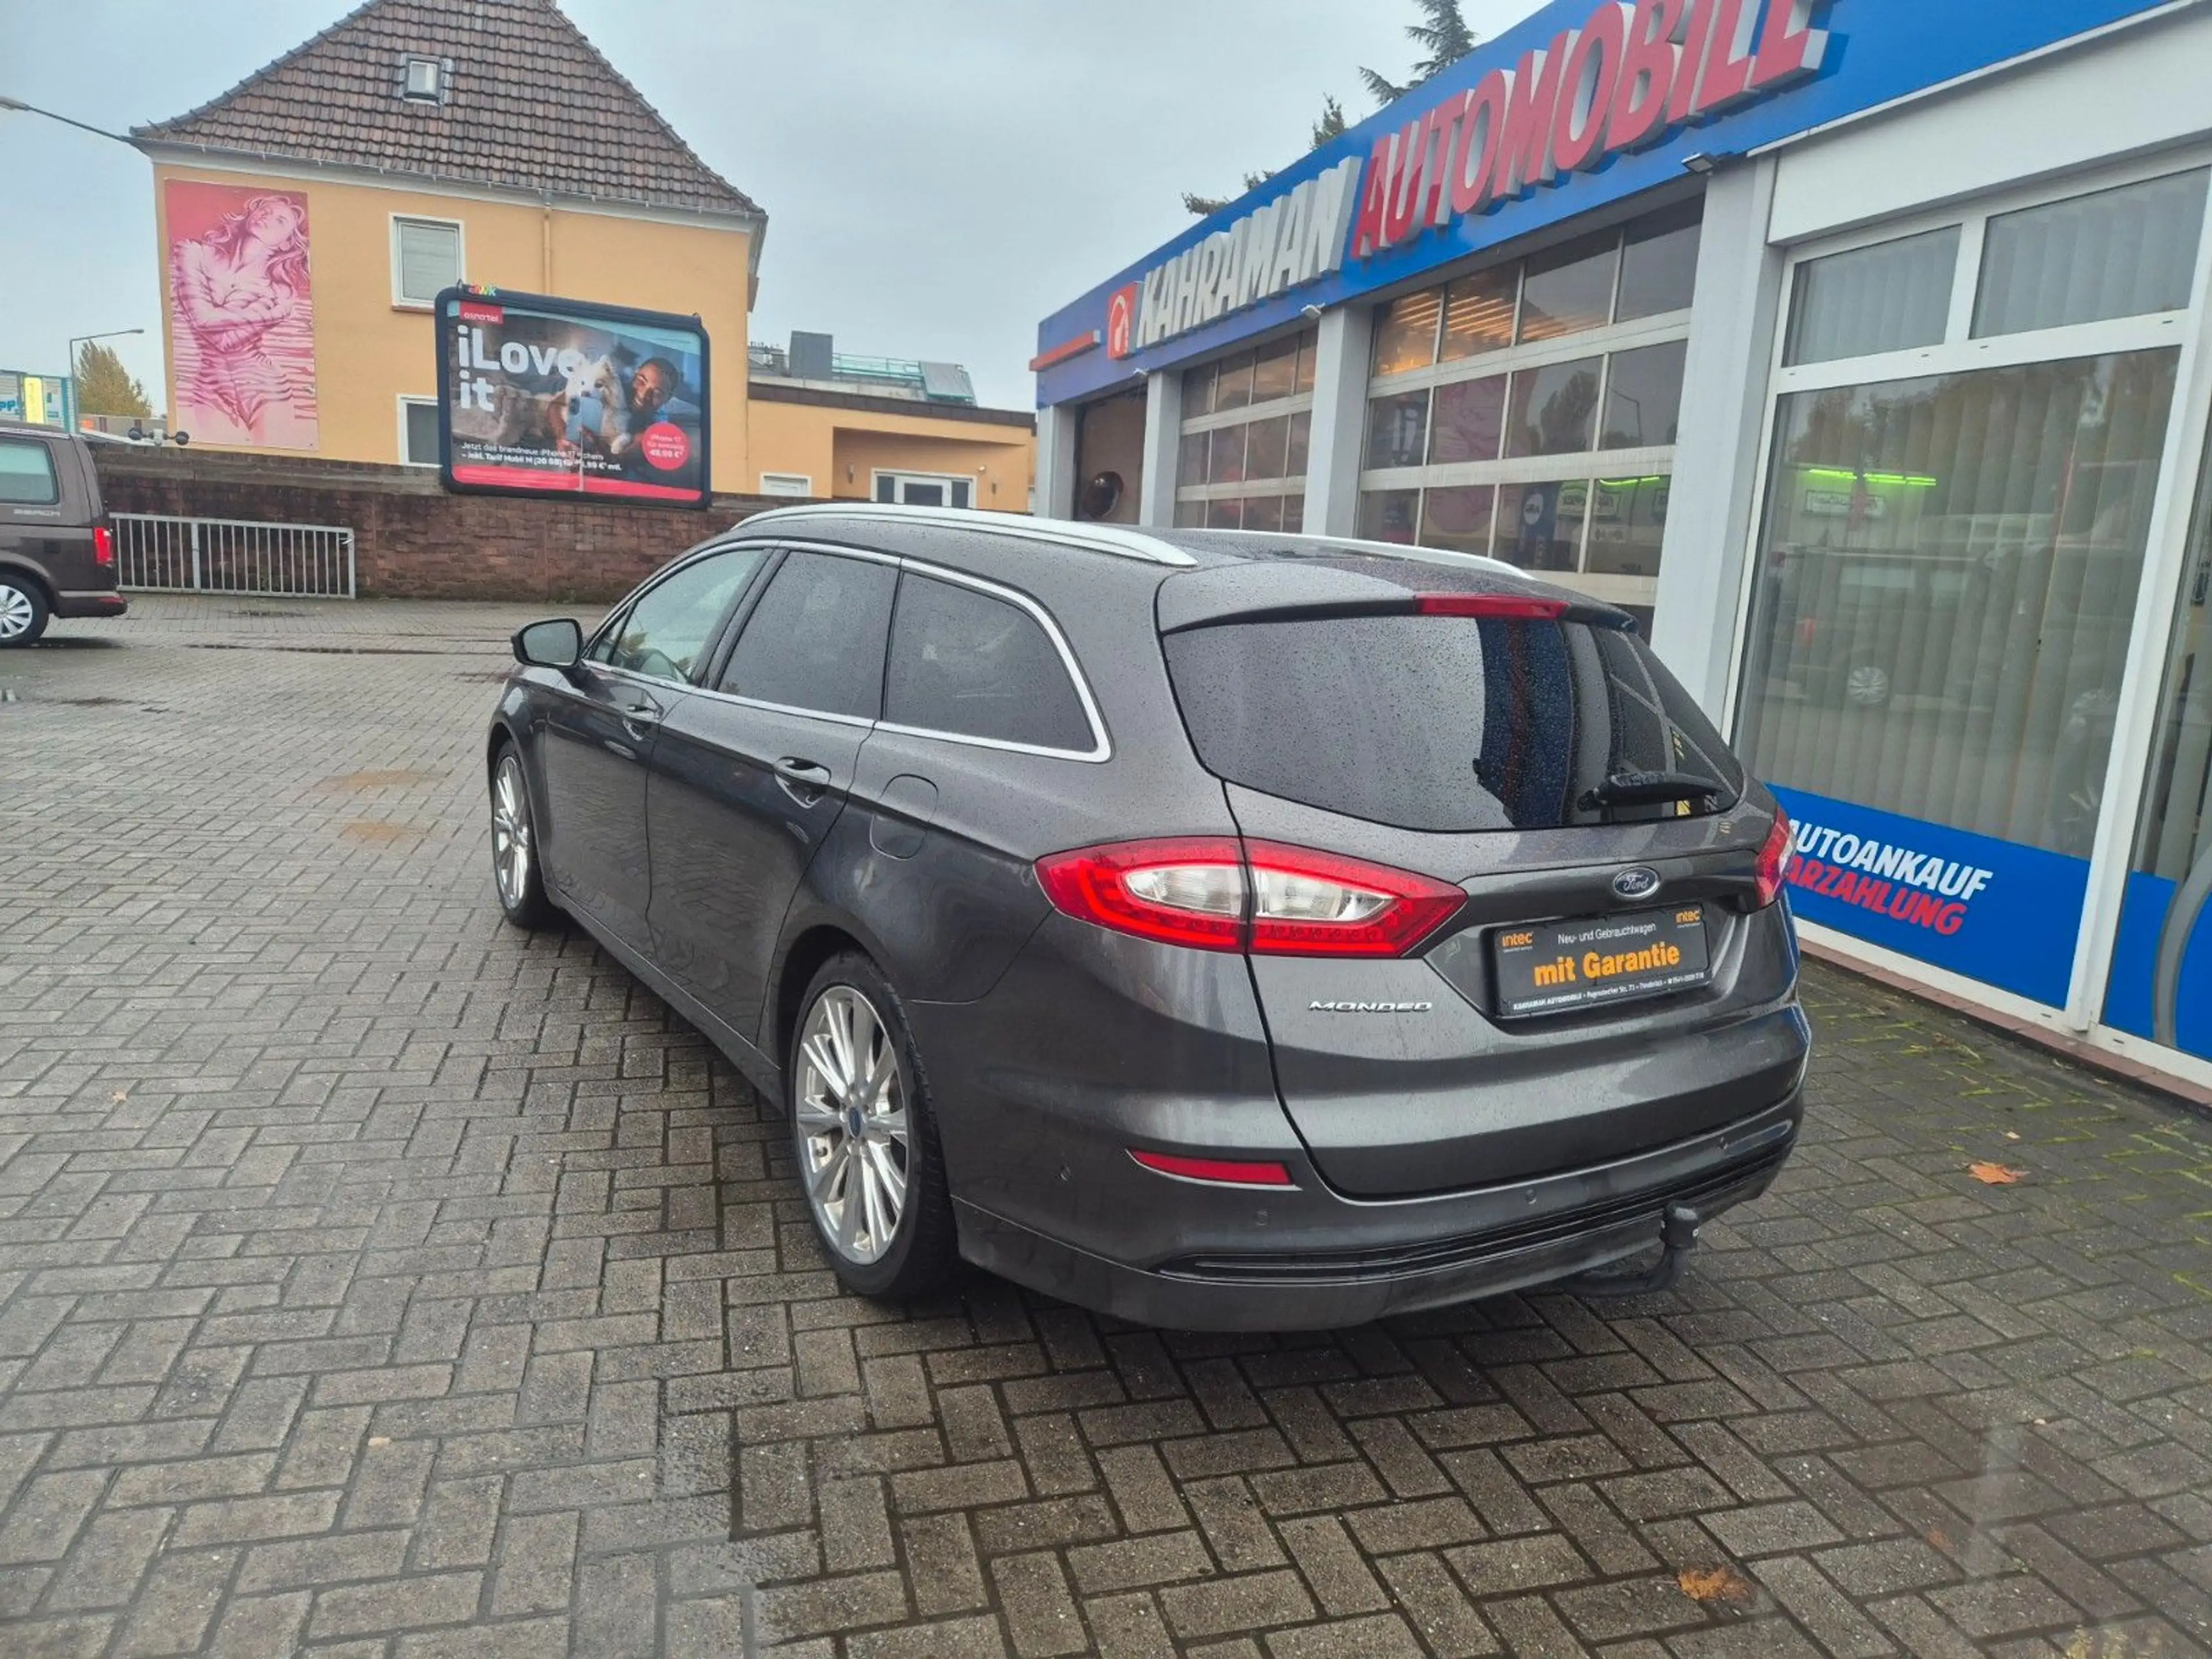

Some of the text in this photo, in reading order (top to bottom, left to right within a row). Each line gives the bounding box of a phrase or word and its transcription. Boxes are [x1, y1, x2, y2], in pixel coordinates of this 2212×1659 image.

[1137, 156, 1363, 349] KAHRAMAN
[459, 369, 494, 412] it
[462, 442, 482, 450] Jetzt
[1623, 874, 1649, 891] Ford
[1675, 910, 1700, 923] intec
[1502, 932, 1533, 948] intec
[1558, 923, 1657, 945] Neu- und Gebrauchtwagen
[1535, 941, 1680, 987] mit Garantie
[1308, 1001, 1433, 1013] MONDEO
